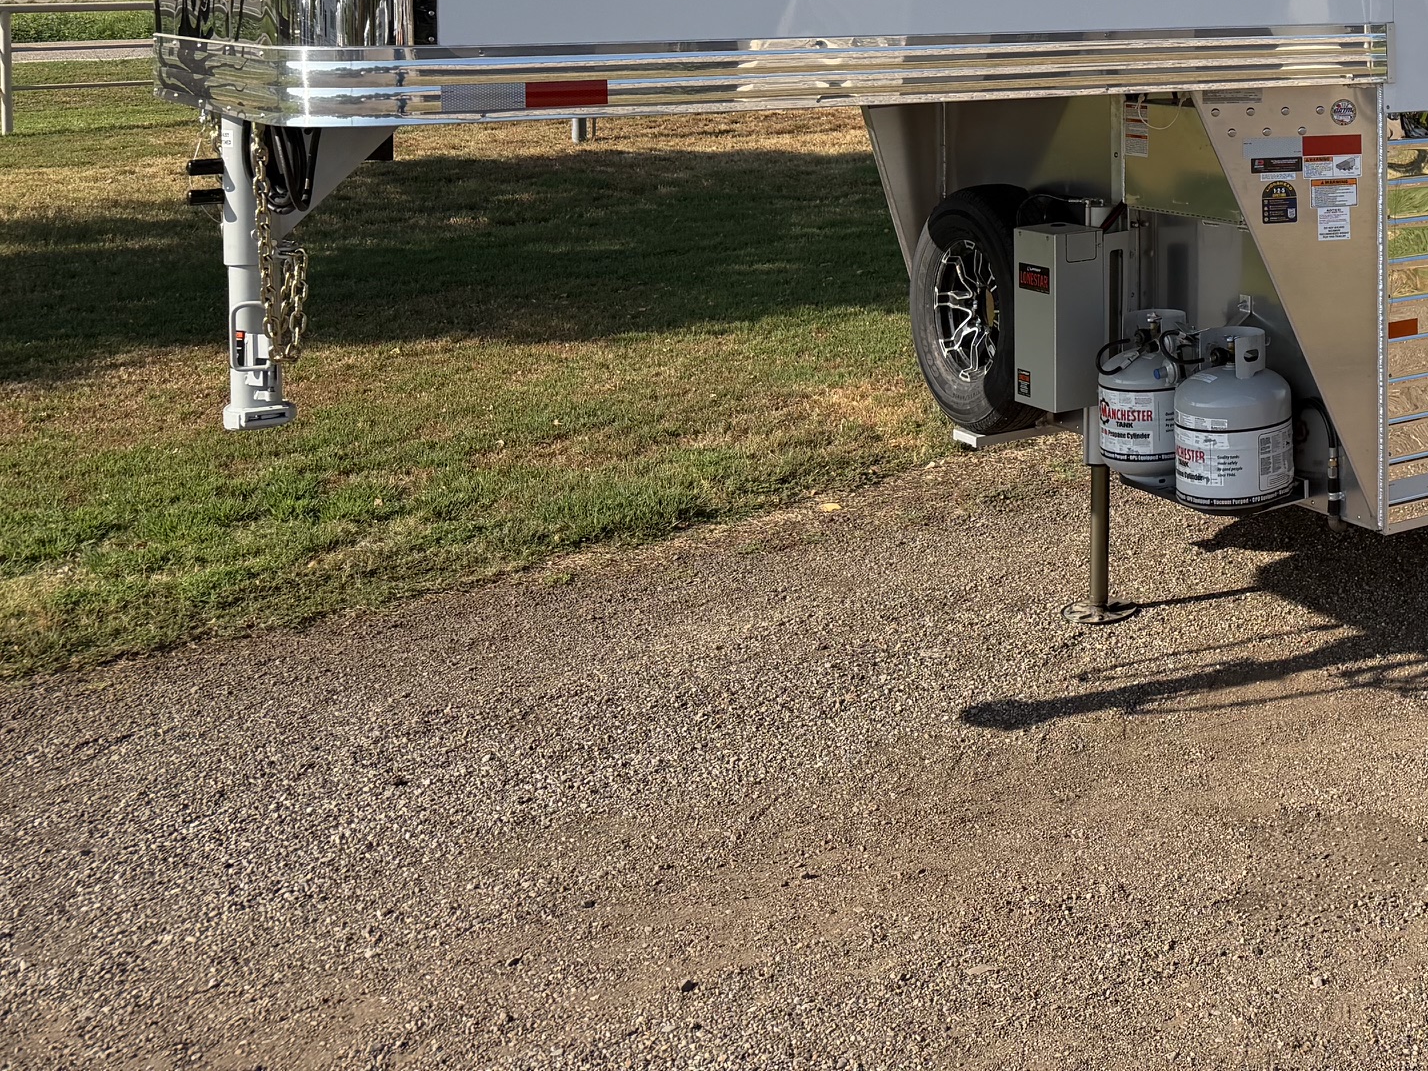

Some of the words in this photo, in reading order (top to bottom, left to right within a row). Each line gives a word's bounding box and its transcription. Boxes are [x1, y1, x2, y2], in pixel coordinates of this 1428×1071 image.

[1020, 271, 1048, 289] LONESTAR
[1101, 402, 1153, 421] MANCHESTER
[1116, 421, 1134, 429] TANK
[1127, 432, 1150, 440] Cylinder
